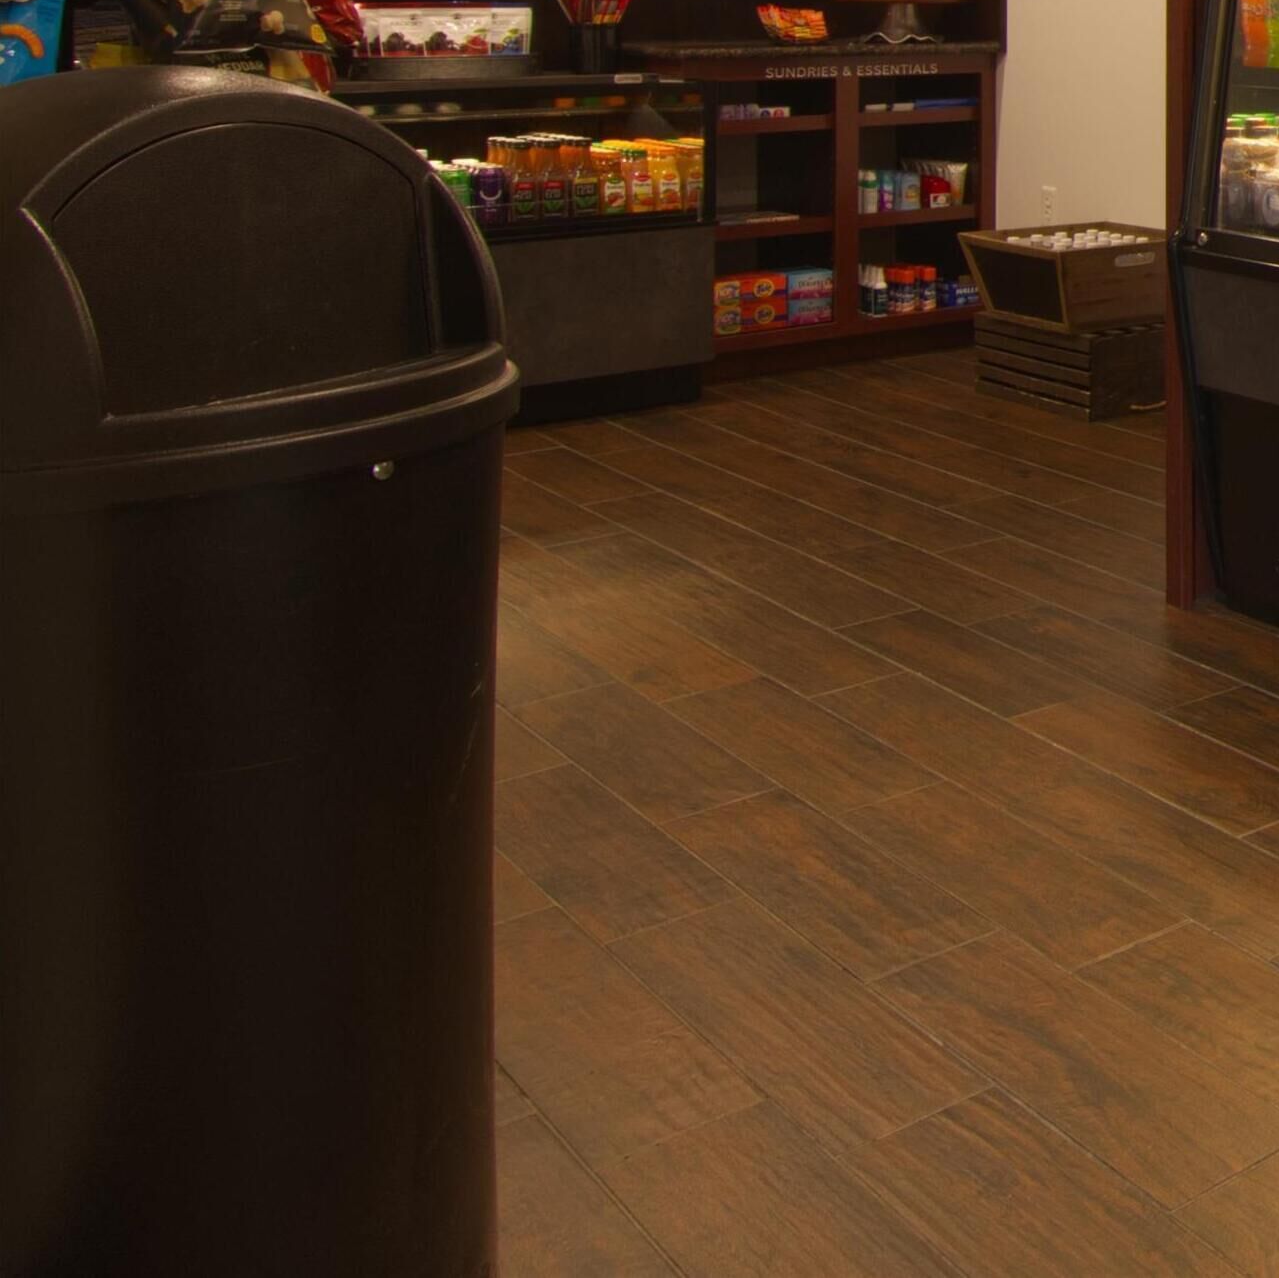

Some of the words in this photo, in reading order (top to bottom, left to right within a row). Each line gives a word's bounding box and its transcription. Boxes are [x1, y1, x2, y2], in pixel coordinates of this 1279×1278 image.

[765, 67, 838, 79] SUNDRIES
[843, 66, 852, 76] &
[856, 63, 939, 76] ESSENTIALS
